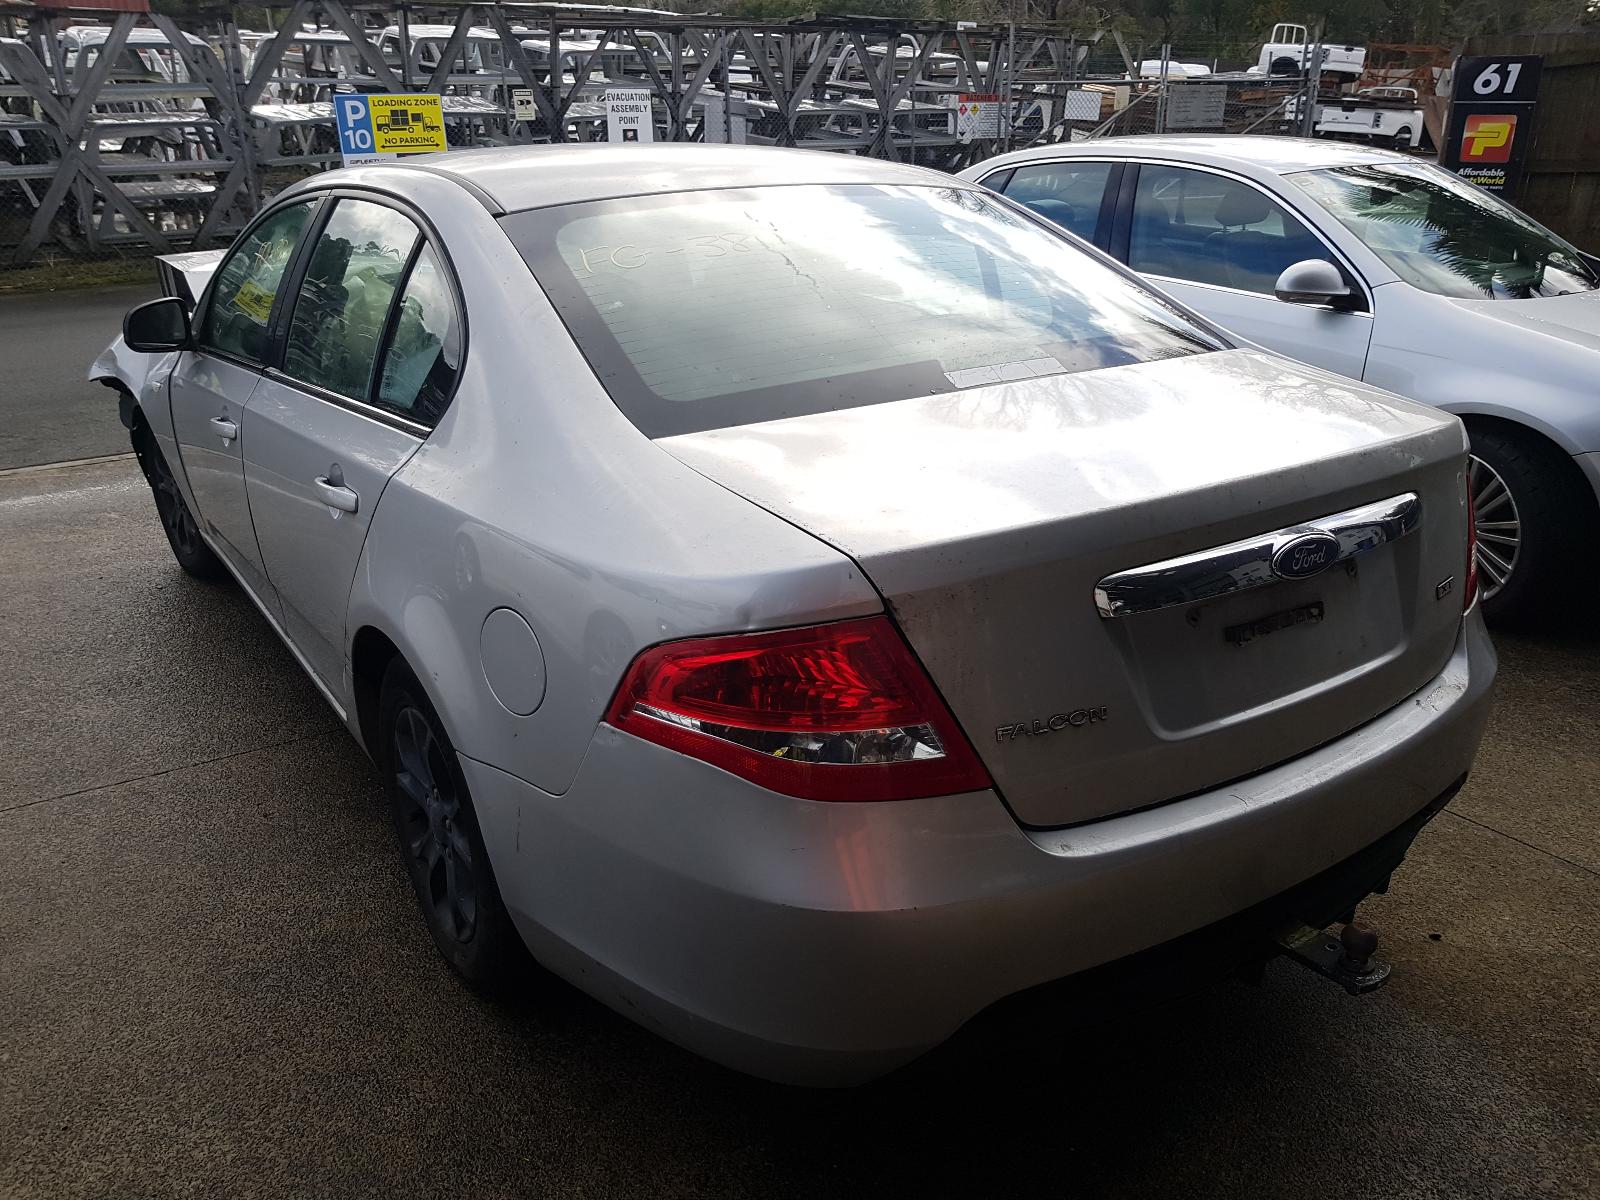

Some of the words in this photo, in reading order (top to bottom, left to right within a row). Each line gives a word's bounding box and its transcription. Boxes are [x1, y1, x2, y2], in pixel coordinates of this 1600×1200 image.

[1473, 63, 1522, 95] 61
[606, 92, 650, 101] EVACUATION
[372, 99, 413, 107] LOADING
[414, 98, 439, 106] ZONE
[611, 104, 648, 113] ASSEMBLY
[344, 100, 366, 128] P
[618, 116, 639, 125] POINT
[344, 129, 372, 149] 10
[384, 137, 398, 145] NO
[399, 136, 436, 145] PARKING
[1457, 167, 1505, 177] Affordable
[1292, 543, 1327, 570] Ford
[996, 706, 1109, 741] FALCON
